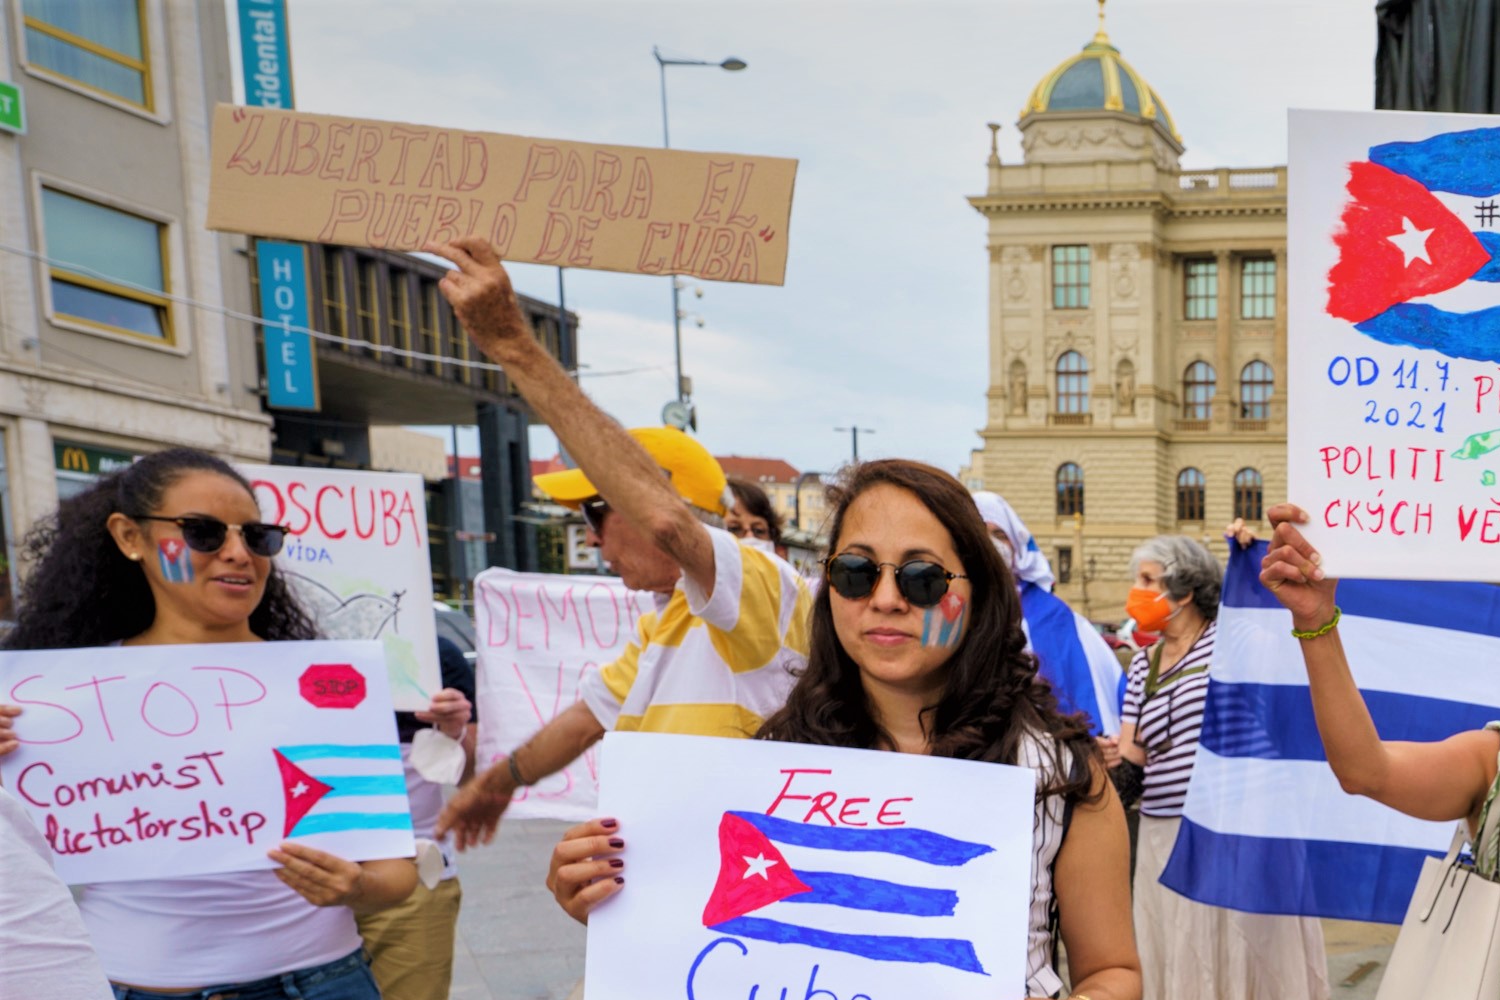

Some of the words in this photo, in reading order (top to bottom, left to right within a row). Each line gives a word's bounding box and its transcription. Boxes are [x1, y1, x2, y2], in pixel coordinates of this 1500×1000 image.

[513, 143, 654, 220] PARA
[694, 160, 758, 228] EL
[534, 211, 601, 265] DE
[272, 257, 298, 393] HOTEL
[1328, 356, 1379, 386] OD
[1393, 360, 1460, 392] 11.7.
[1365, 400, 1445, 433] 2021
[1320, 445, 1445, 482] POLITI
[1324, 489, 1433, 536] CKÝCH
[10, 666, 266, 744] STOP
[312, 678, 359, 696] STOP
[765, 768, 914, 827] FREE
